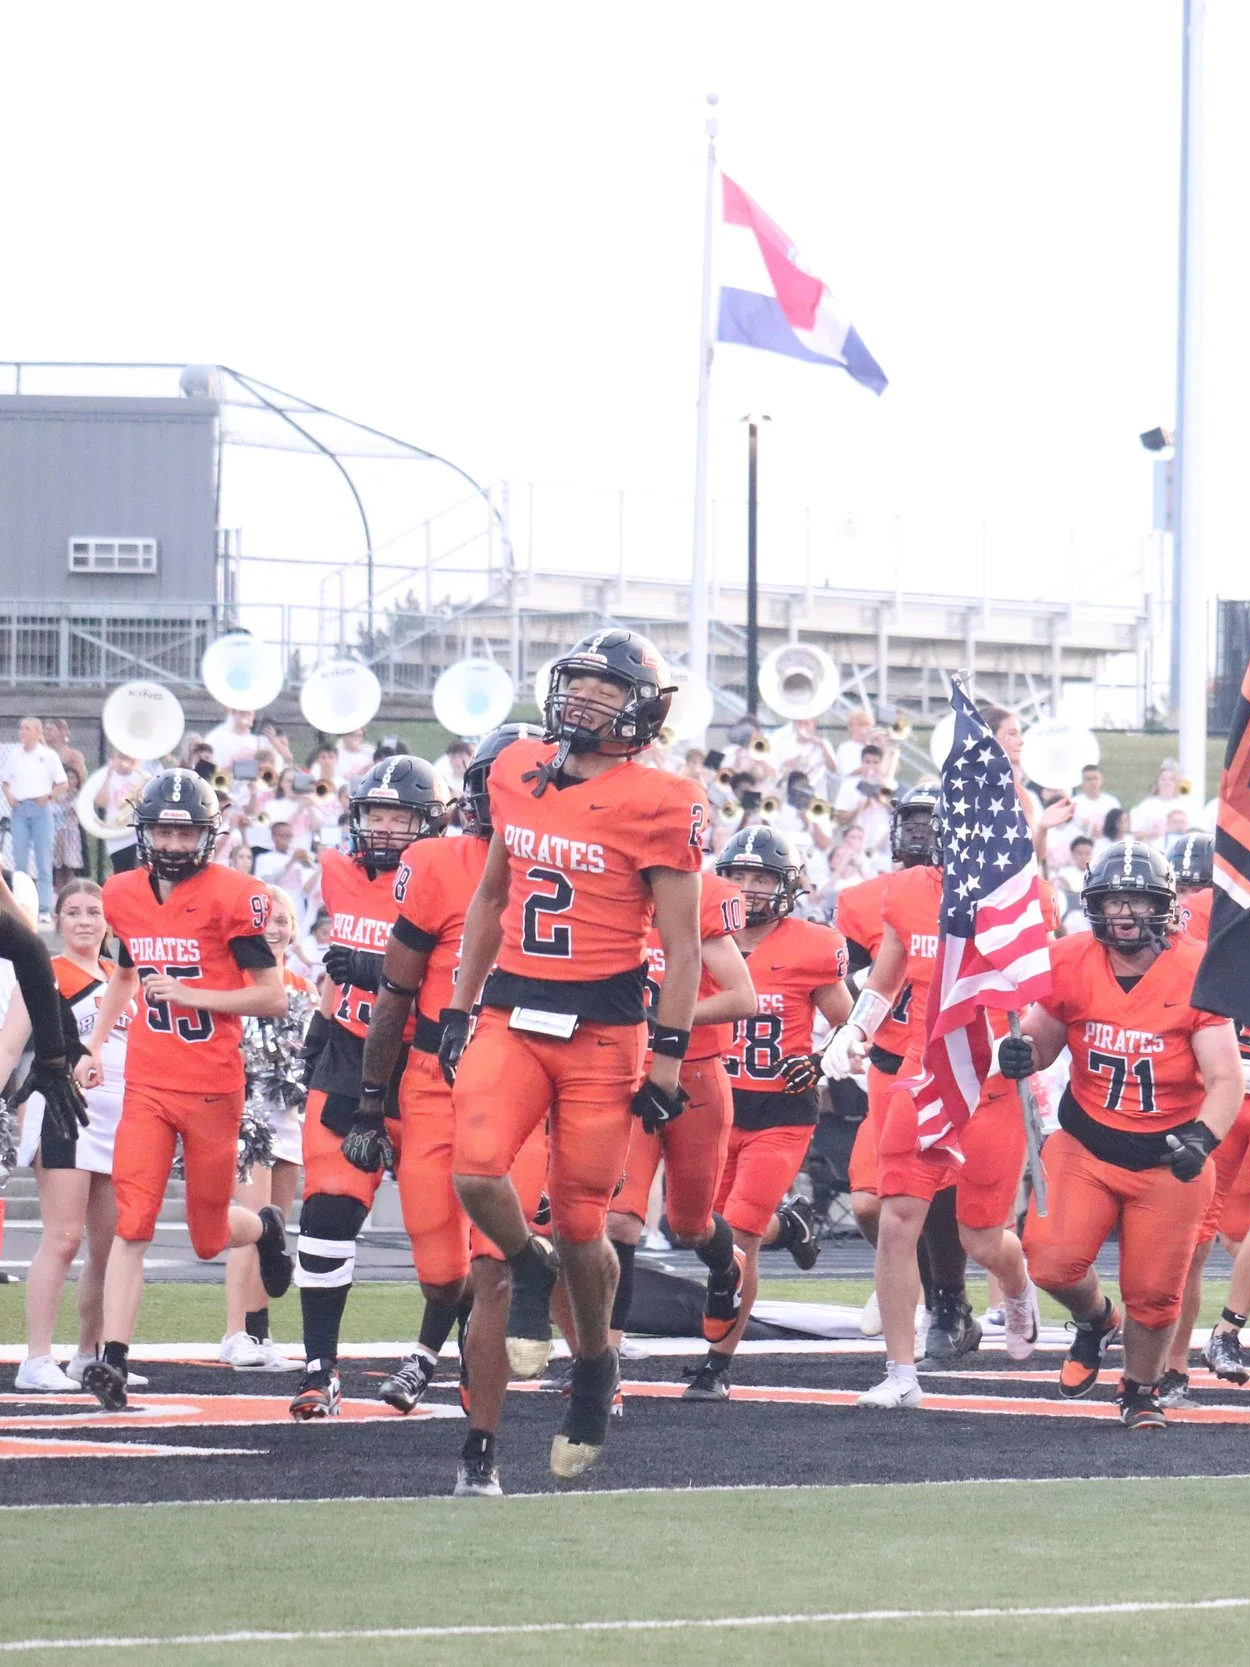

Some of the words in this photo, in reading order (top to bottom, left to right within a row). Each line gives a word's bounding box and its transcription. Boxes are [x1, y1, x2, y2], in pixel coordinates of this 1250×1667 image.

[688, 803, 705, 847] 2
[504, 823, 605, 873] PIRATES
[521, 865, 574, 959] 2
[721, 897, 742, 932] 10
[129, 937, 201, 961] PIRATES
[1083, 1021, 1164, 1054] PIRATES
[1088, 1048, 1161, 1113] 71
